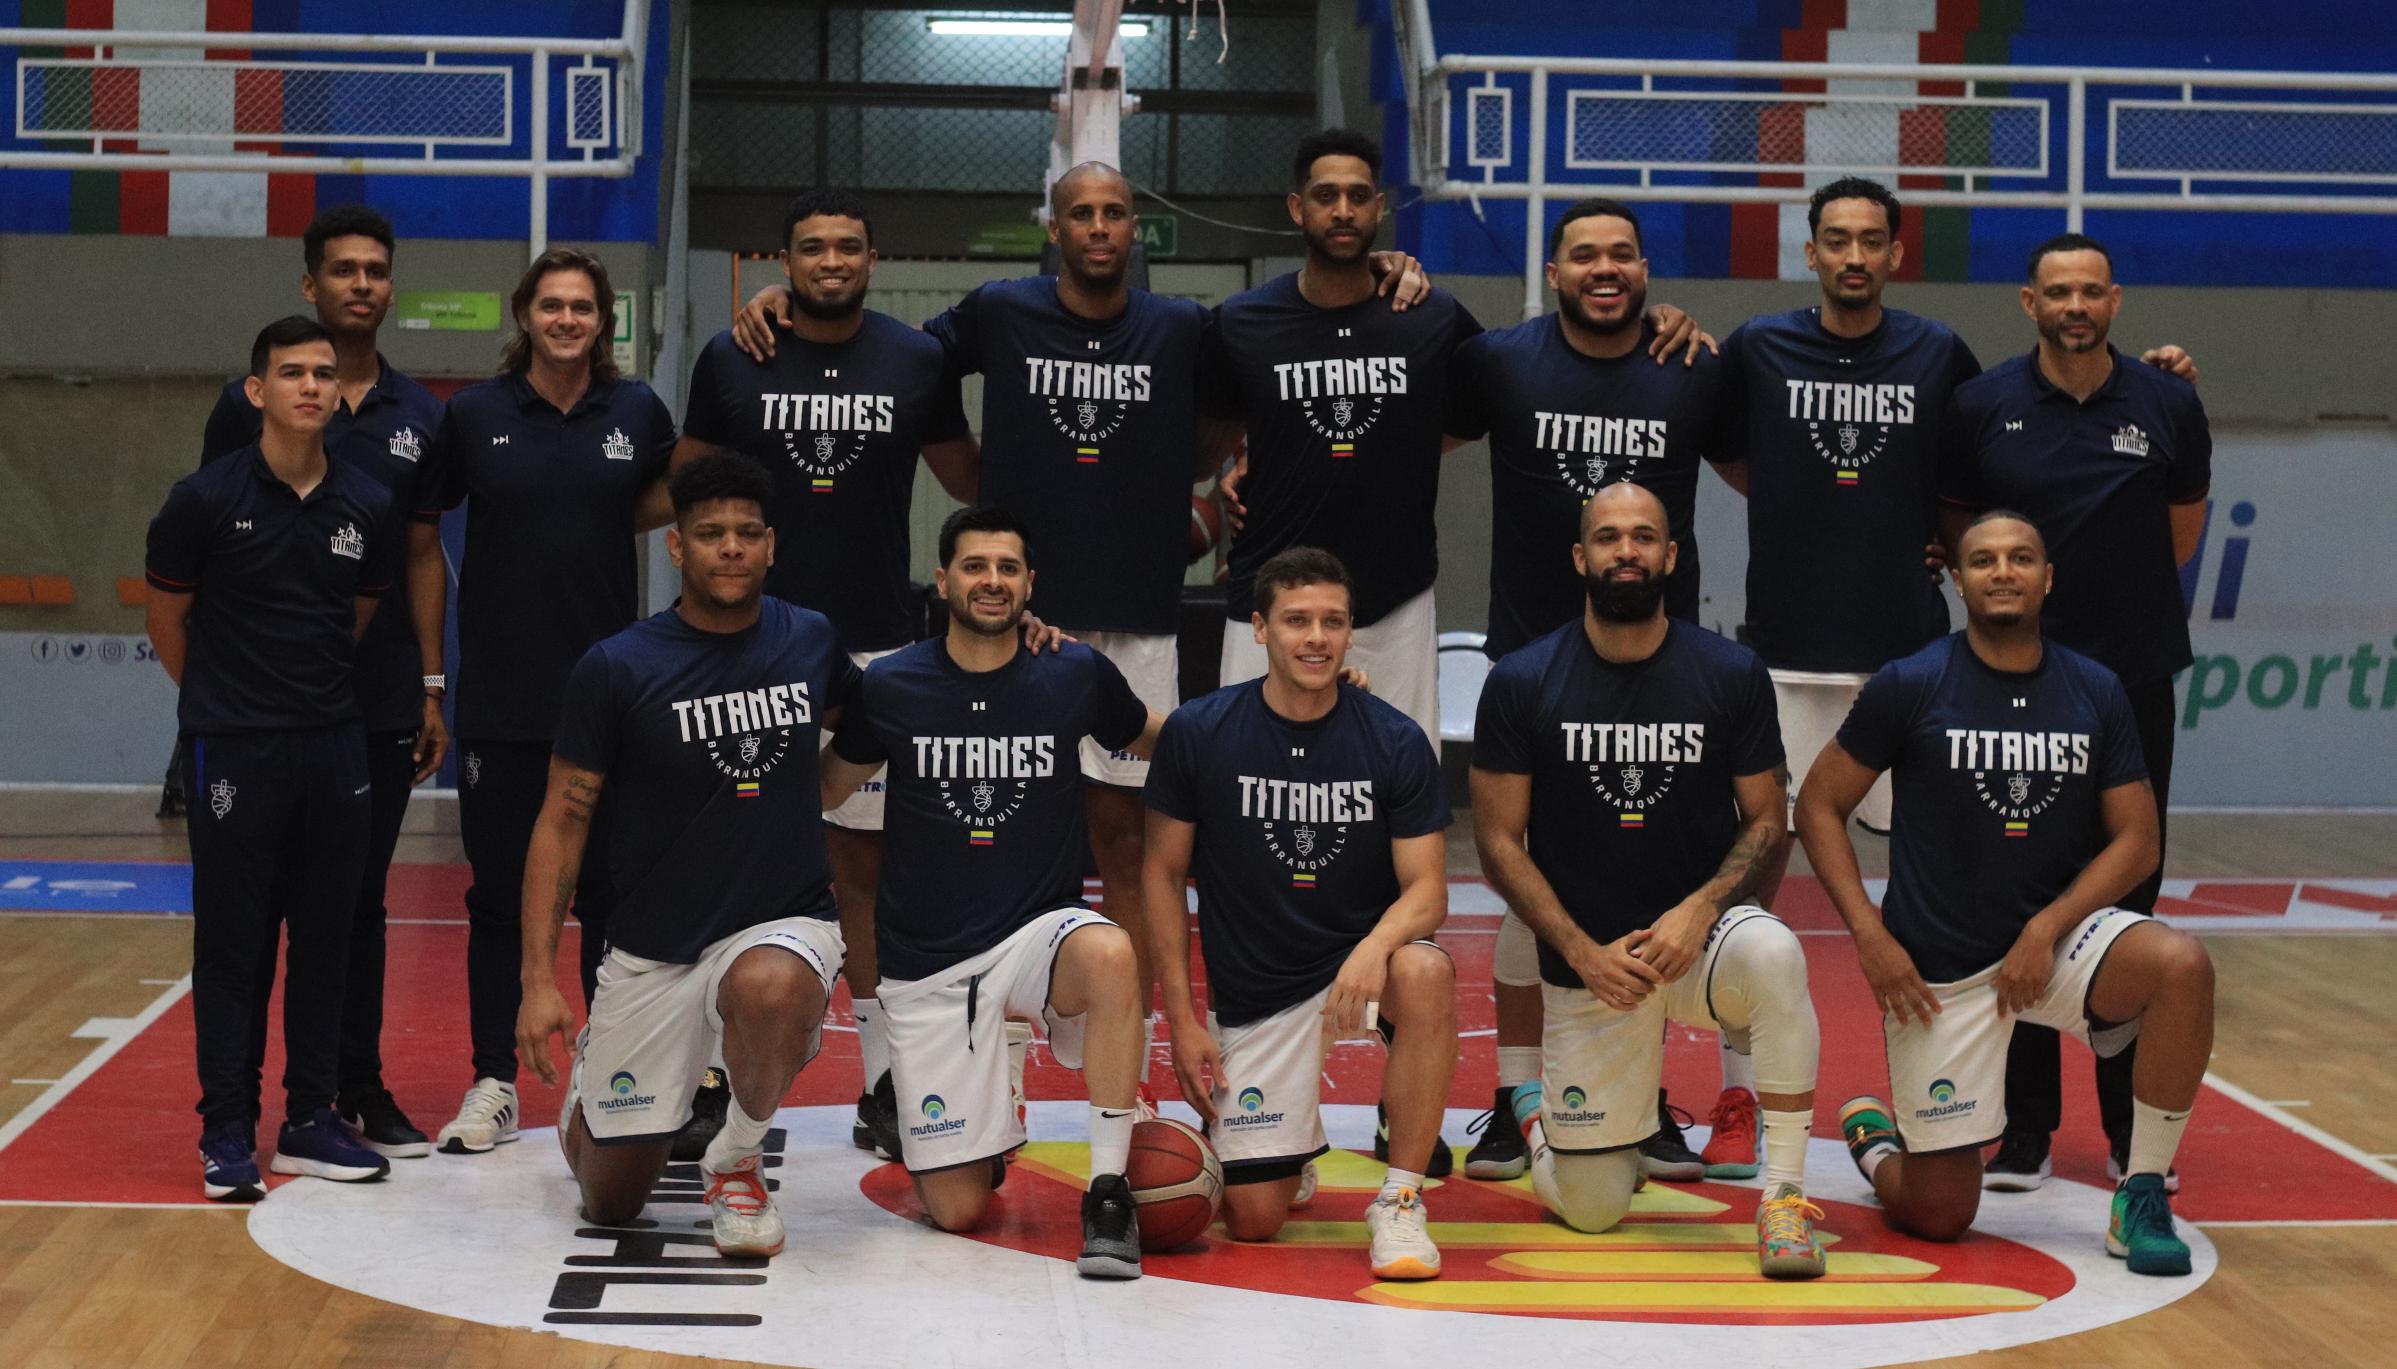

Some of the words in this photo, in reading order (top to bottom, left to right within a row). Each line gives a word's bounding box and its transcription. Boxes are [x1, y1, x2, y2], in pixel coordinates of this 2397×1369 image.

[1026, 357, 1150, 402] TITANES
[1273, 356, 1406, 400] TITANES
[761, 393, 893, 432] TITANES
[1049, 398, 1127, 442] BARRANQUILLA
[1303, 396, 1383, 440] BARRANQUILLA
[1786, 379, 1915, 424] TITANES
[602, 443, 634, 458] TITANES
[785, 432, 867, 475] BARRANQUILLA
[1535, 411, 1666, 458] TITANES
[1809, 422, 1890, 467] BARRANQUILLA
[2111, 434, 2150, 454] TITANES
[1557, 453, 1637, 497] BARRANLLA
[331, 536, 364, 557] TITANES
[671, 681, 812, 743] TITANES
[707, 729, 790, 778] BARRANQUILLA
[912, 735, 1054, 778] TITANES
[1561, 722, 1704, 763] TITANES
[1945, 728, 2090, 775] TITANES
[940, 781, 1026, 827] BARRANQUILLA
[1237, 775, 1374, 823] TITANES
[1589, 765, 1674, 809] BARRANQUILLA
[1975, 772, 2063, 818] BARRANQUILLA
[1264, 822, 1347, 870] BARRANQUILLA
[598, 1094, 656, 1110] mutualser
[1223, 1111, 1284, 1127] mutualser
[1552, 1110, 1606, 1122] mutualser
[1915, 1100, 1977, 1119] mutualser
[910, 1119, 966, 1136] mutualser
